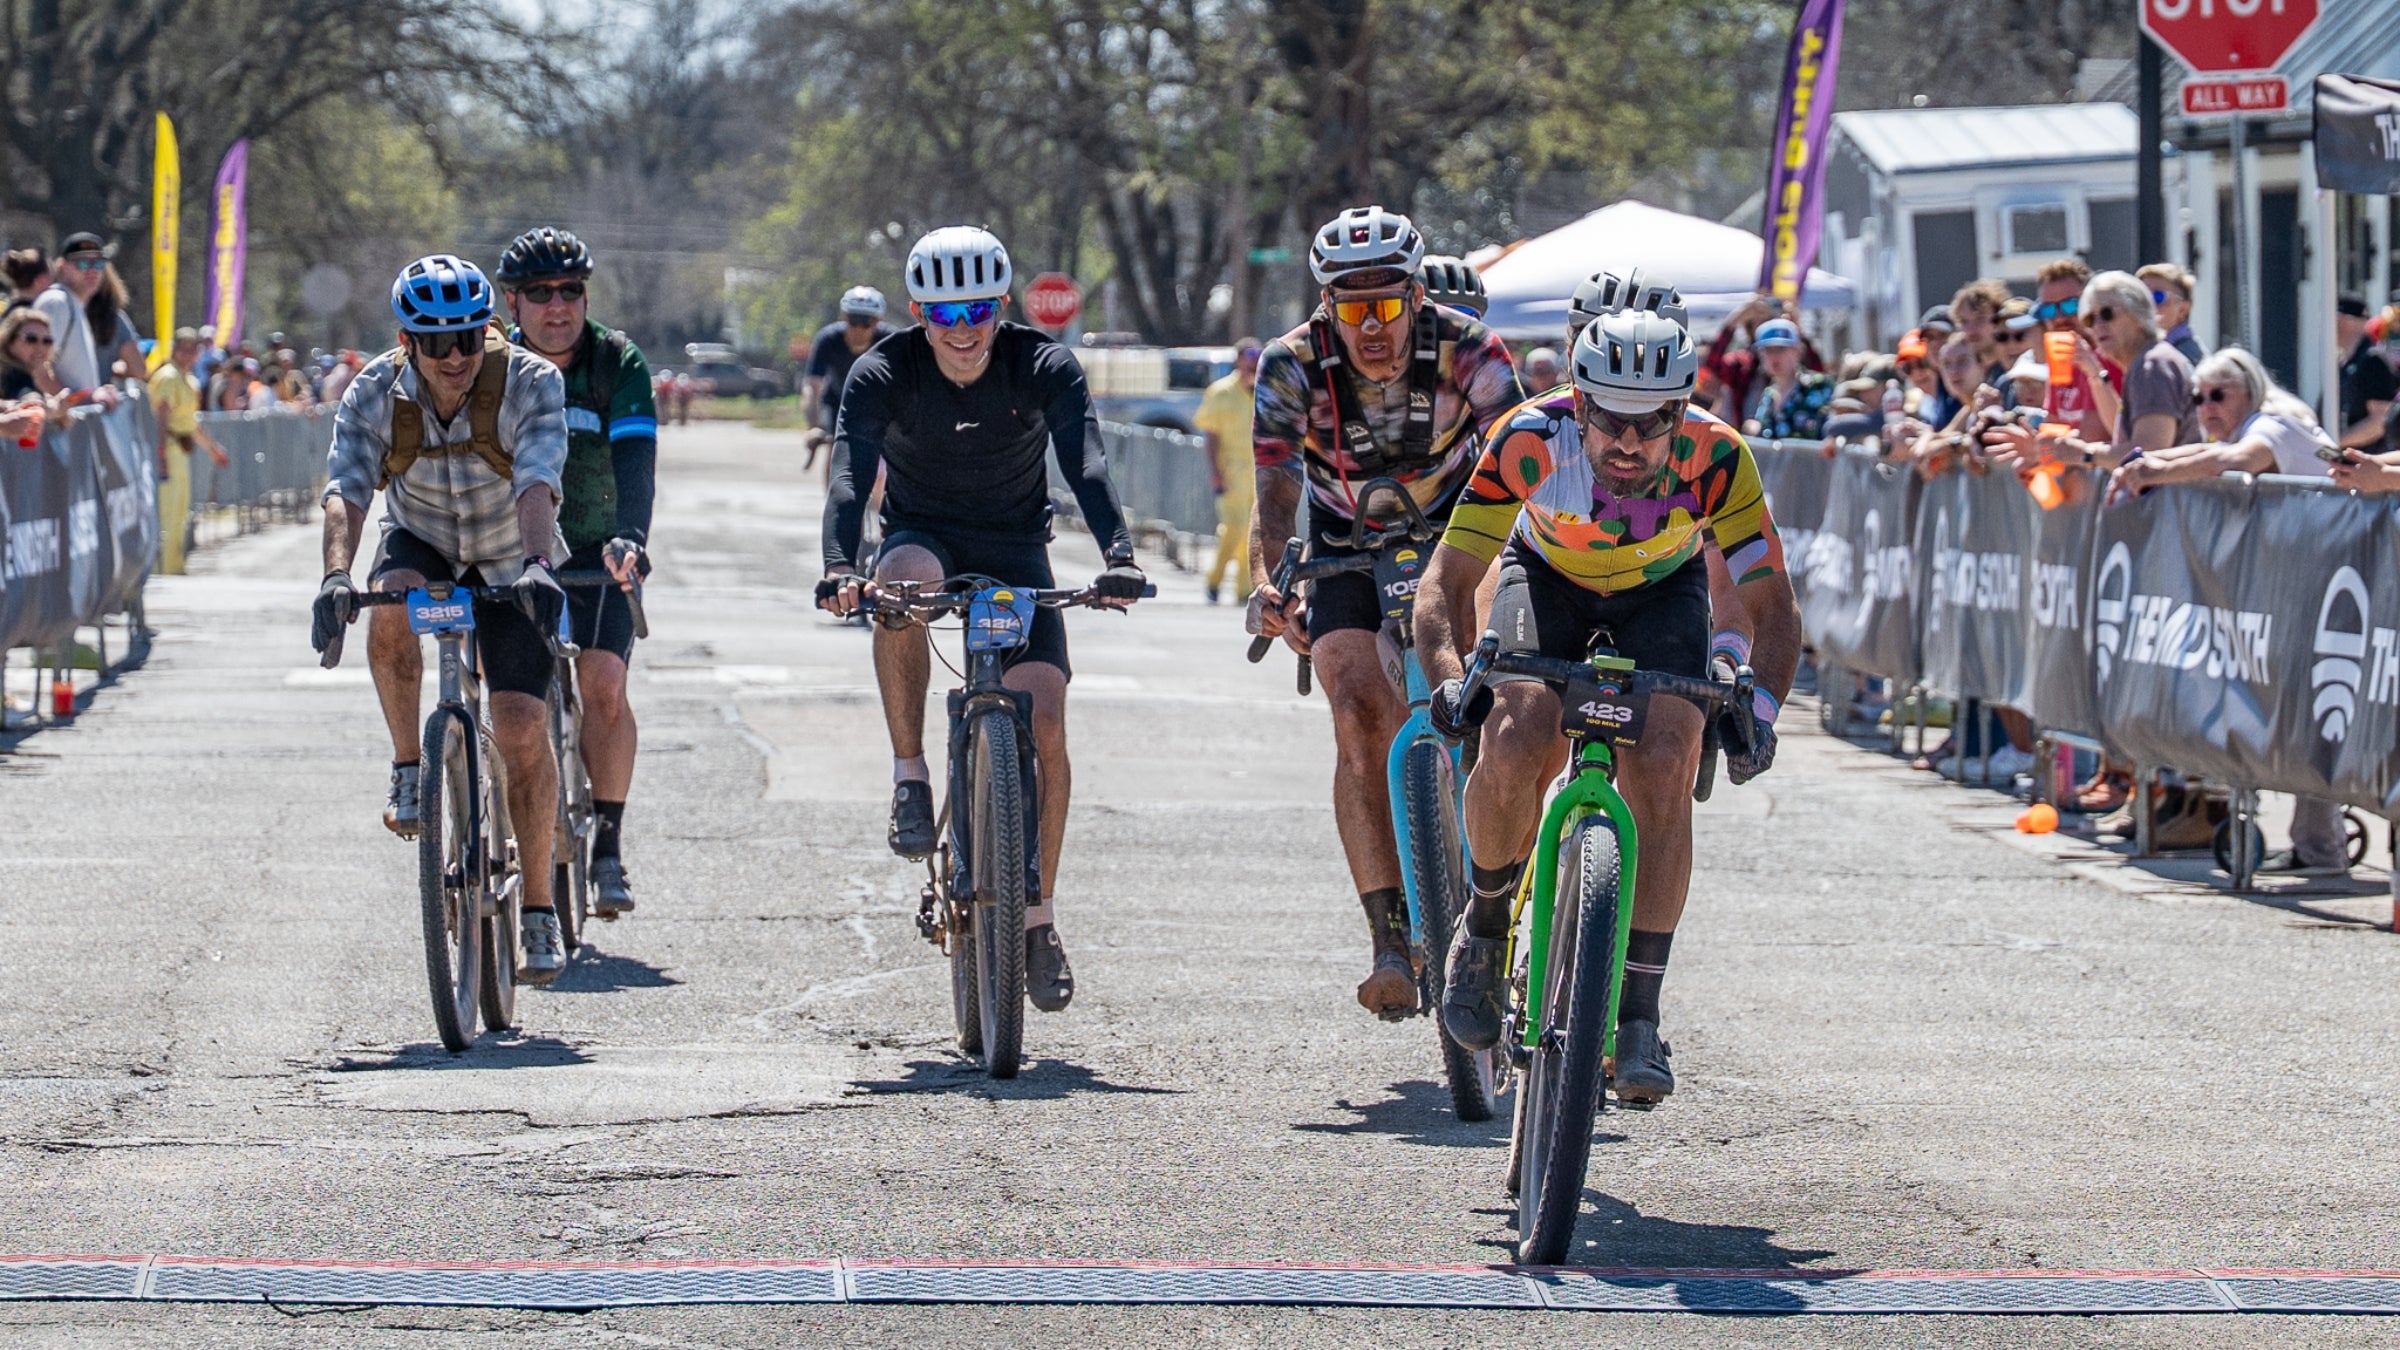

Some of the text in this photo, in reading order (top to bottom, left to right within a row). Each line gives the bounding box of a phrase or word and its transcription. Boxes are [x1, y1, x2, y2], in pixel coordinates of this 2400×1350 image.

[2189, 83, 2281, 109] ALL WAY
[415, 605, 465, 620] 3215
[1578, 700, 1633, 723] 423
[1585, 717, 1621, 729] 100 MILE
